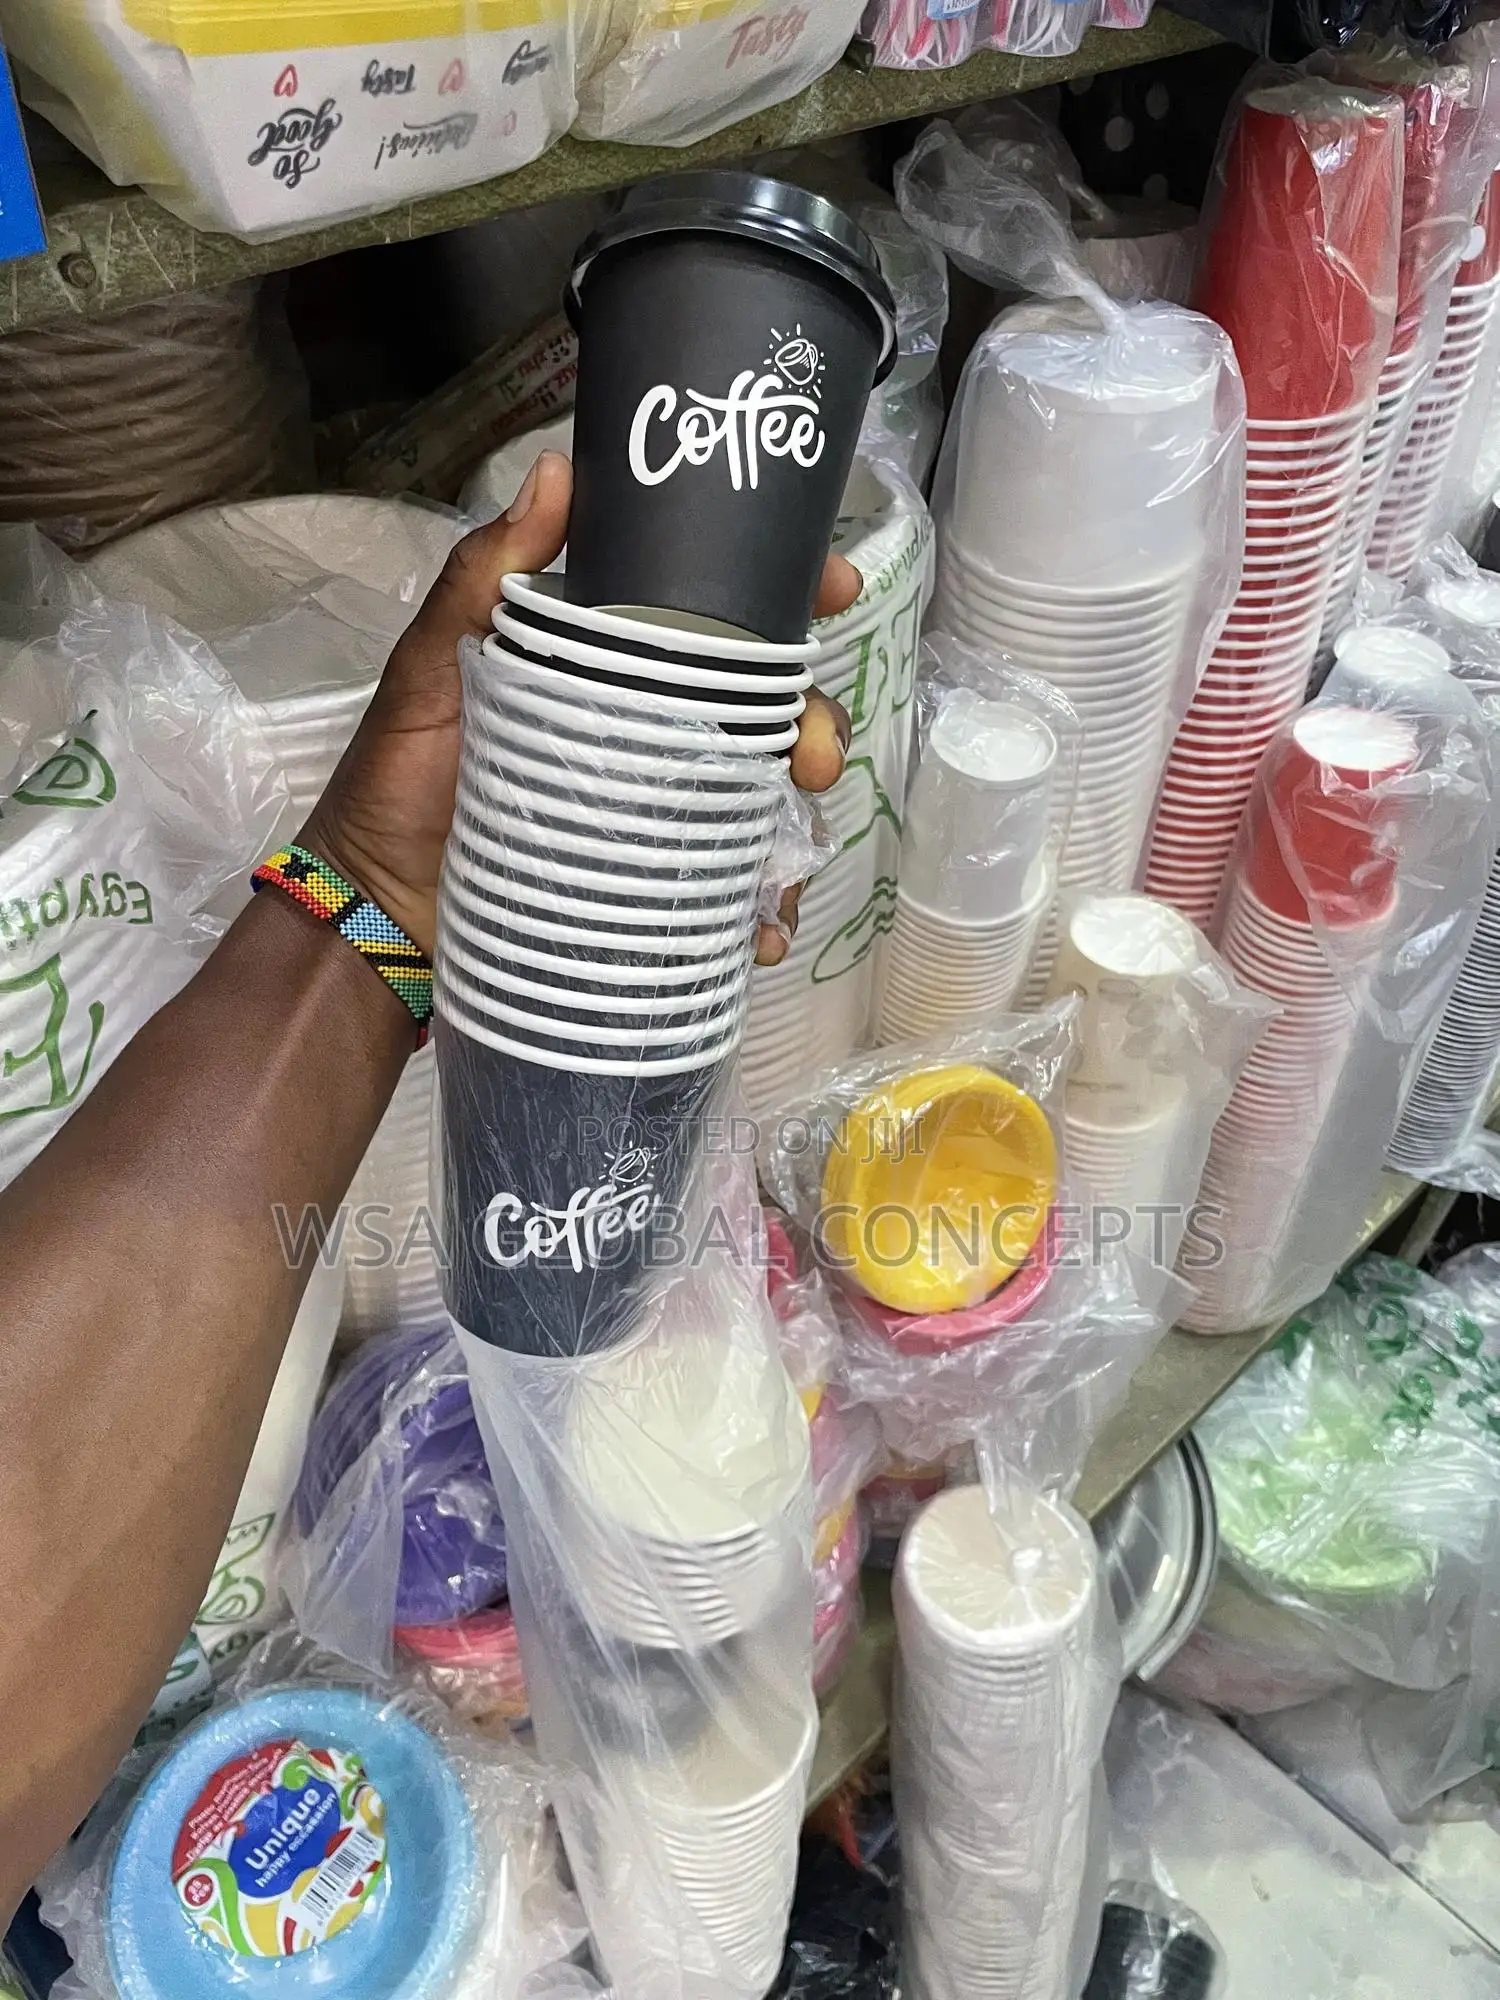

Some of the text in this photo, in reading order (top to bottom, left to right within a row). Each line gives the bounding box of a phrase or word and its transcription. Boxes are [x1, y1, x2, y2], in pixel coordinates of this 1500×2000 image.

[629, 370, 826, 491] Coffee
[484, 1185, 664, 1273] Coffee
[245, 1788, 321, 1870] Unique
[255, 1851, 292, 1888] happy
